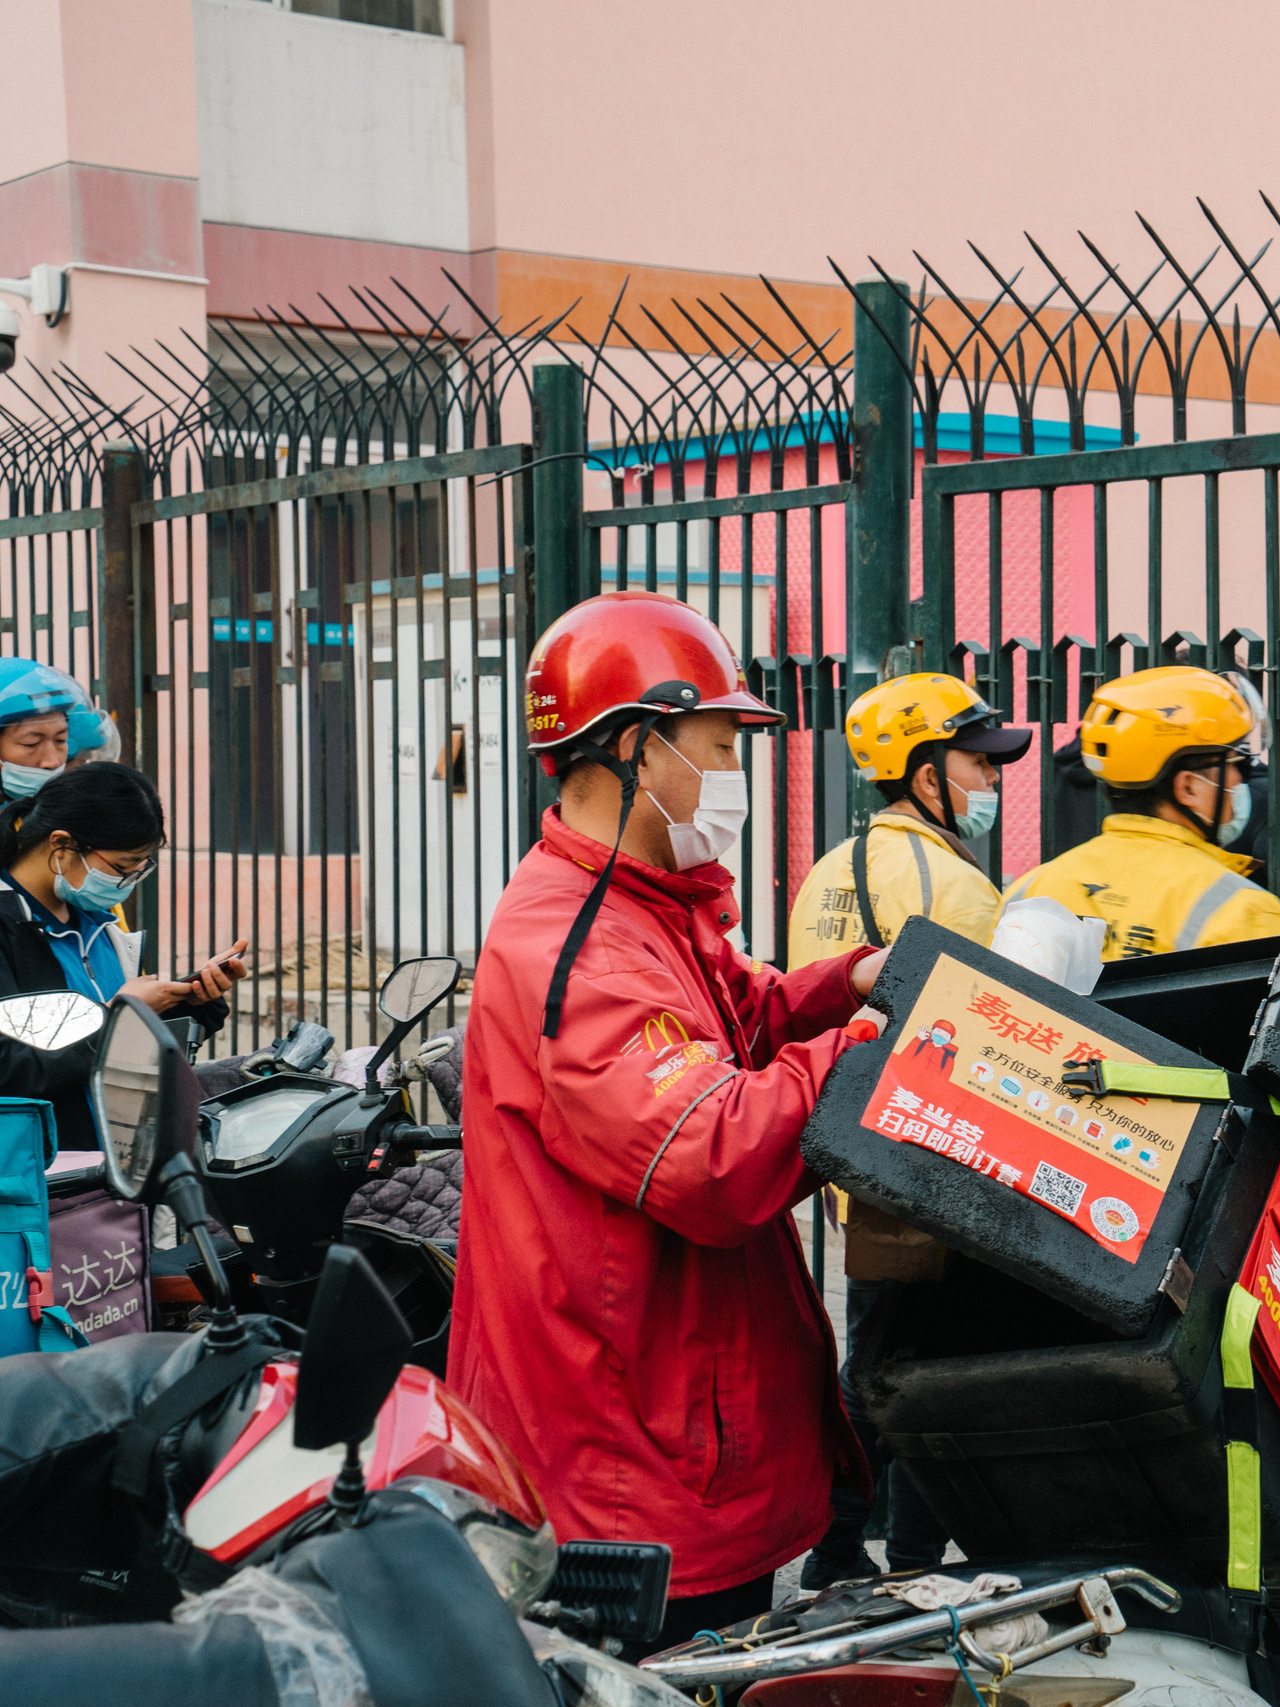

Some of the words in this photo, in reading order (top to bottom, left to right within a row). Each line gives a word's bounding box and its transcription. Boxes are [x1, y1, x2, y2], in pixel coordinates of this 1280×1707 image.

[820, 888, 880, 915] 美团
[966, 991, 1064, 1055] 麦乐送
[887, 1086, 985, 1145] 麦当劳
[979, 1045, 1084, 1104] 全方位安全服务
[1086, 1099, 1175, 1152] 只为你的放心
[876, 1108, 1024, 1188] 扫码即刻订餐
[61, 1241, 136, 1310] 达达
